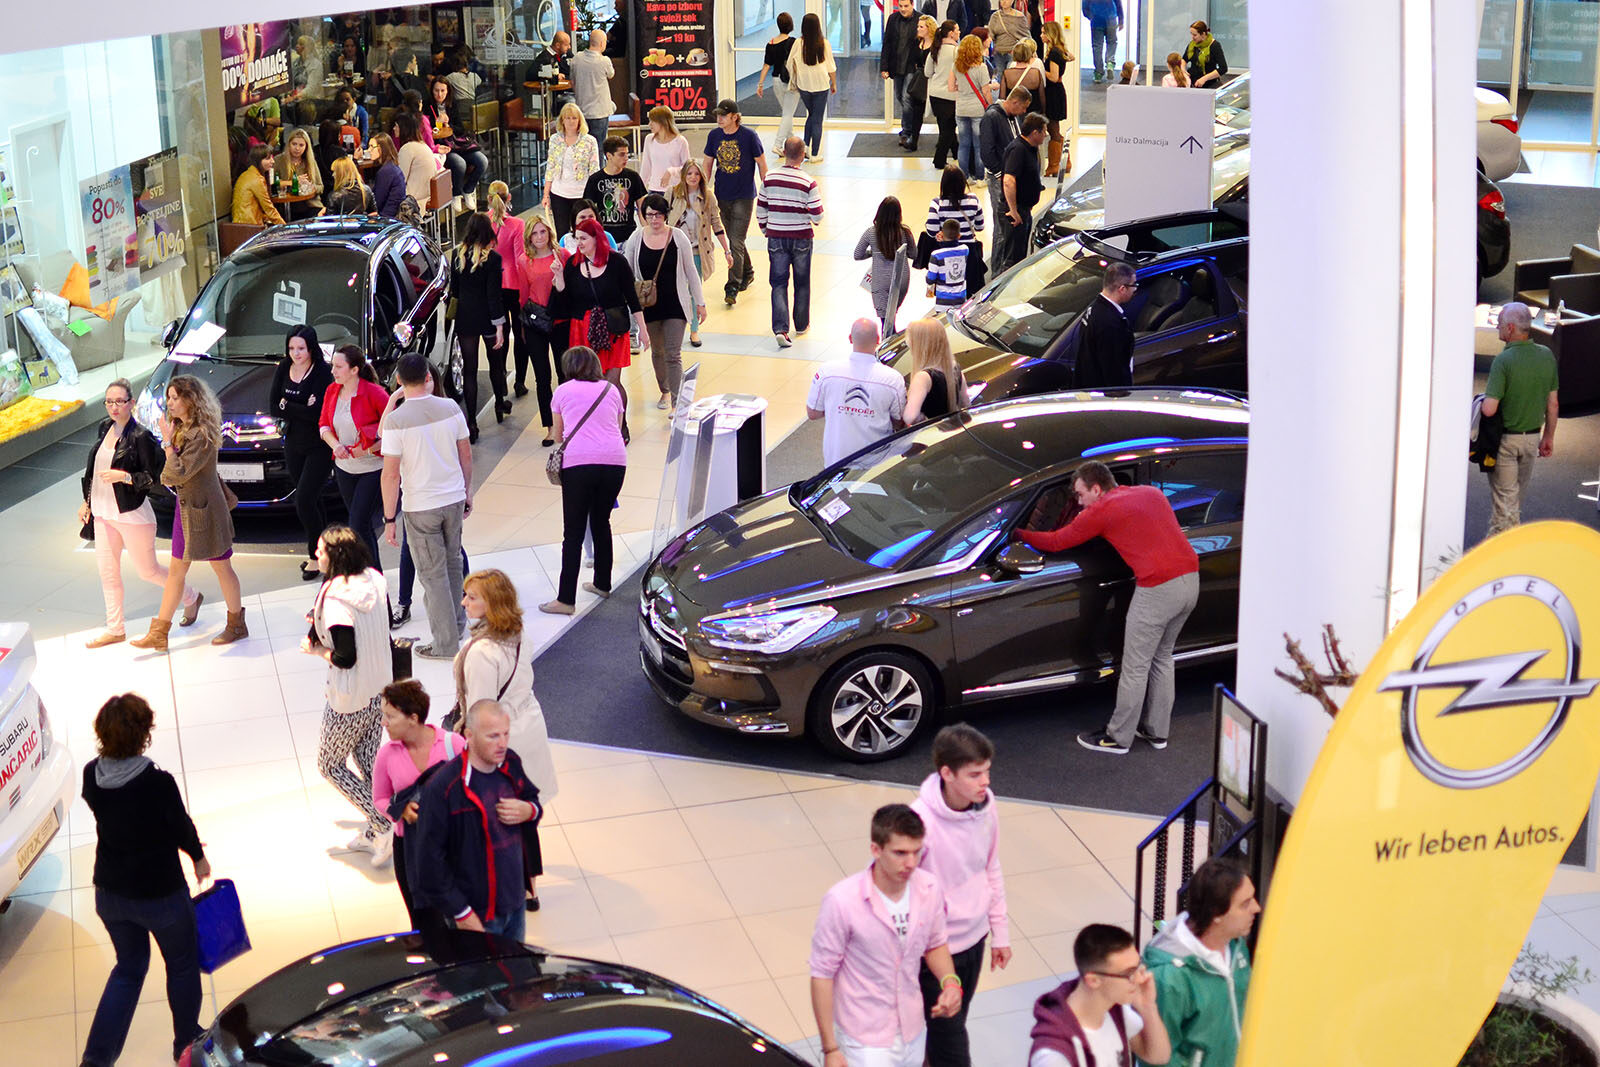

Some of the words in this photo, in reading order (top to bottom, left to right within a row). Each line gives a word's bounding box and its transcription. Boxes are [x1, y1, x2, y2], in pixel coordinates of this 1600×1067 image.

[646, 3, 665, 12] Kava
[667, 4, 677, 12] po
[678, 2, 703, 11] izboru
[682, 13, 697, 22] sok
[673, 33, 683, 42] 19
[684, 32, 695, 42] kn
[248, 49, 288, 83] DOMAĆE
[660, 78, 692, 88] 21-01h
[644, 86, 708, 110] -50%
[1115, 136, 1131, 144] Ulaz
[1133, 137, 1169, 147] Dalmacija
[89, 178, 113, 195] Popusti
[113, 176, 121, 186] do
[149, 185, 164, 199] SVE
[597, 178, 632, 192] GREED
[92, 198, 125, 224] 80%
[137, 200, 181, 227] POSTELJINE
[599, 210, 629, 223] GLORY
[139, 230, 185, 269] -70%
[1454, 579, 1561, 616] OPEL
[0, 717, 29, 756] SUBARU
[1374, 837, 1412, 862] Wir
[1418, 829, 1487, 856] leben
[1494, 824, 1565, 850] Autos.
